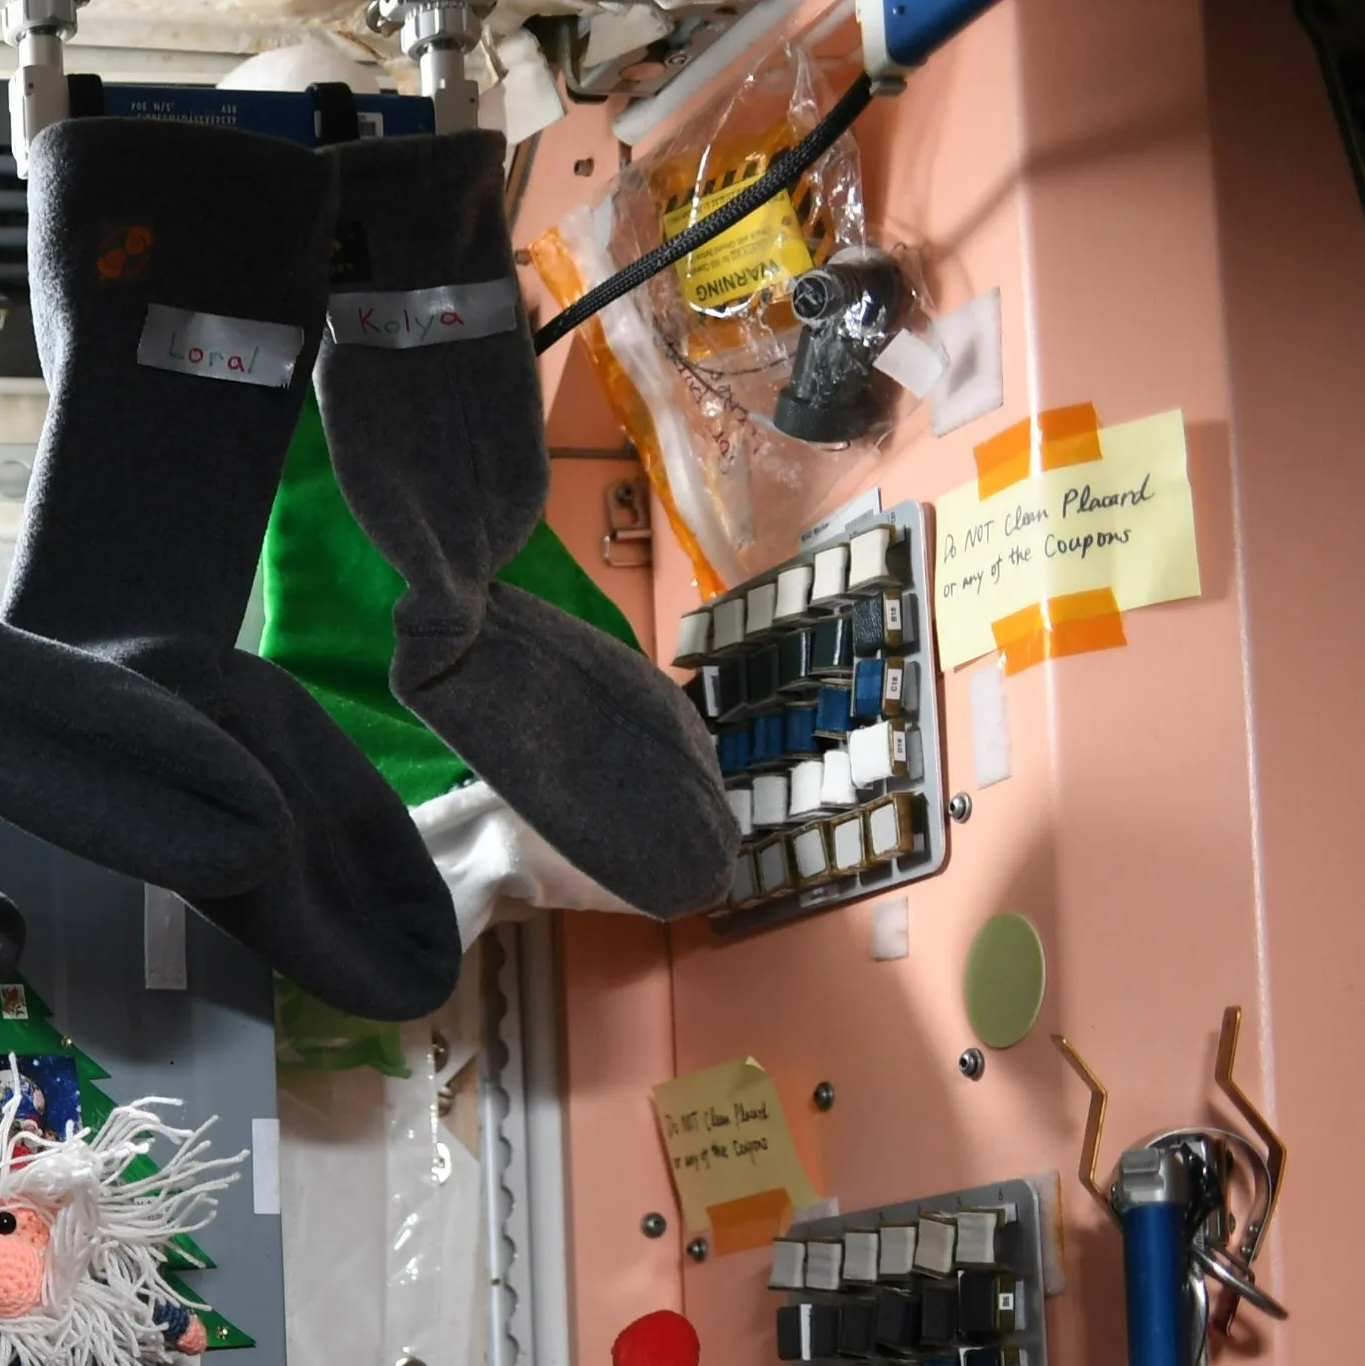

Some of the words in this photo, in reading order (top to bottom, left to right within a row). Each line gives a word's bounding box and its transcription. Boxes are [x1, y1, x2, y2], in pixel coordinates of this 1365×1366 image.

[696, 259, 780, 301] WARNING
[358, 307, 465, 341] Kolya
[964, 519, 995, 548] NOT
[962, 569, 984, 595] any
[1008, 544, 1032, 566] the
[1044, 527, 1132, 559] Coupons
